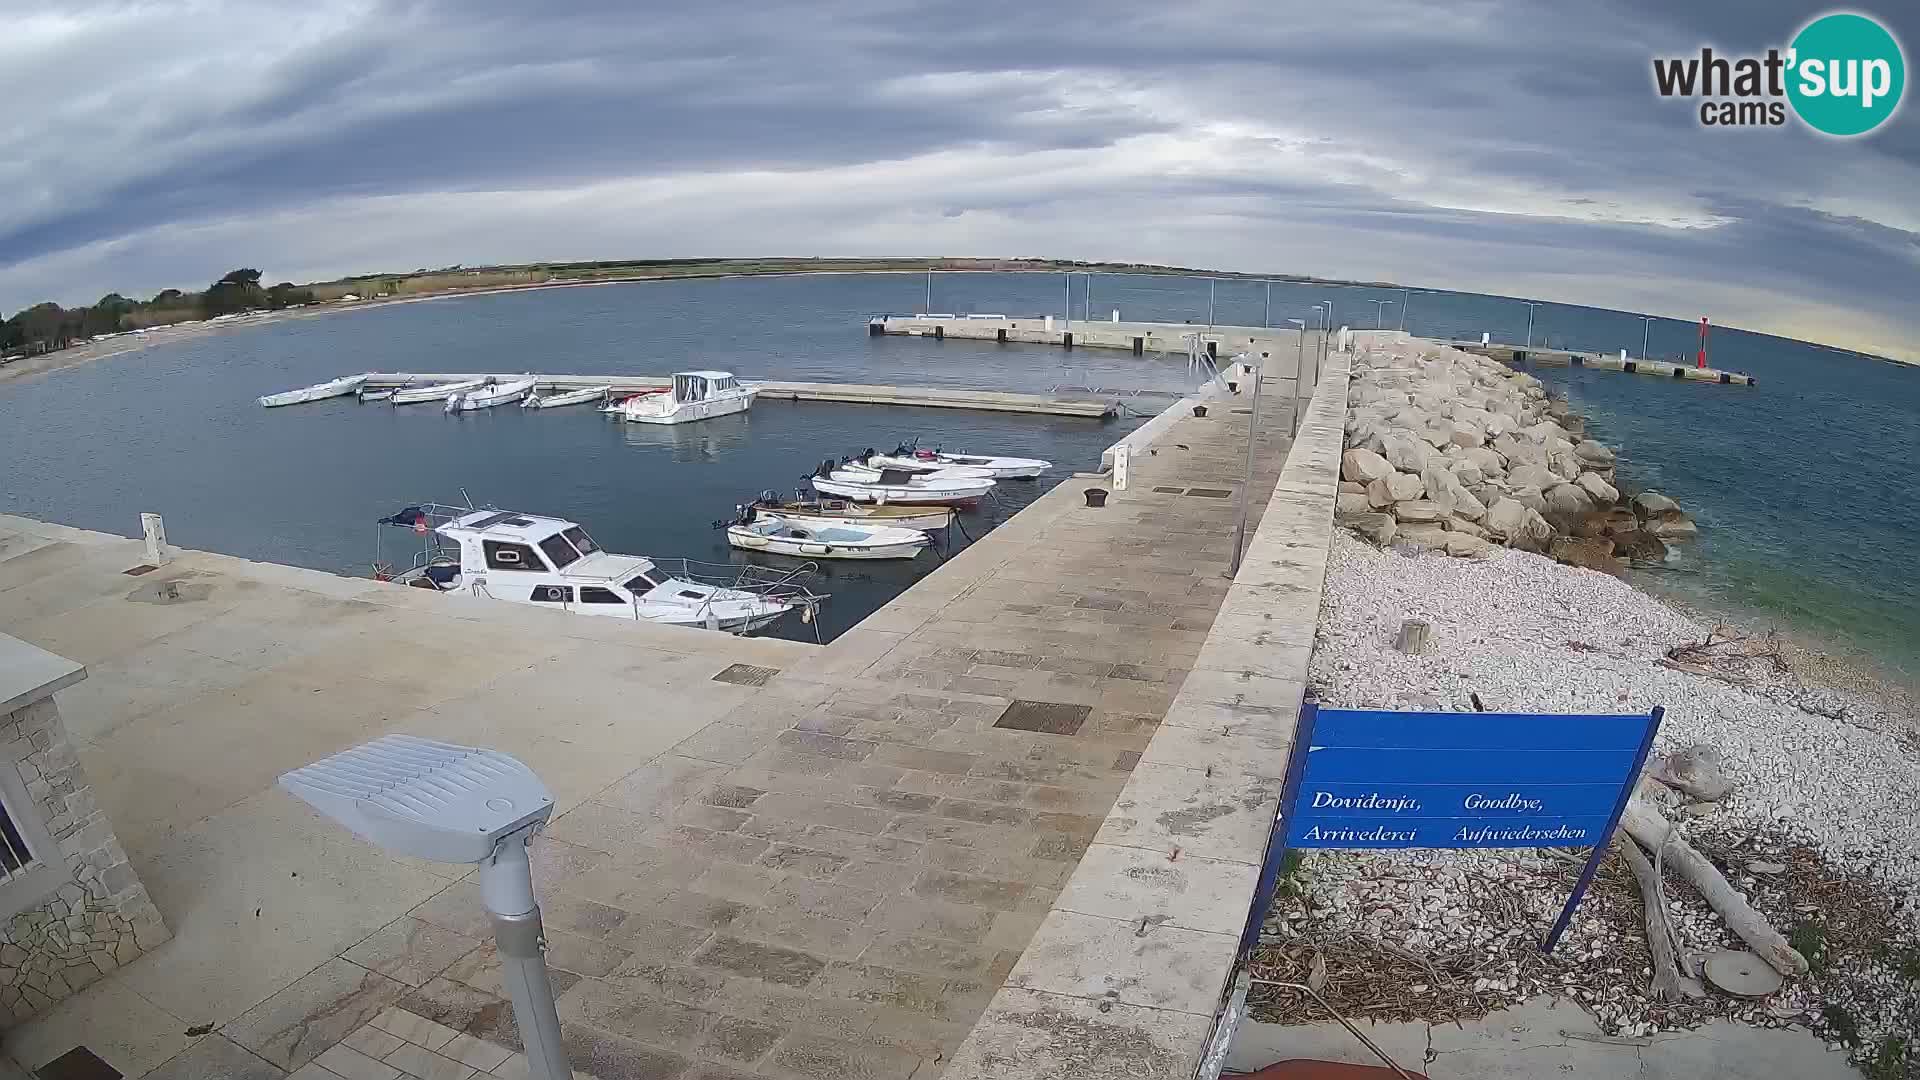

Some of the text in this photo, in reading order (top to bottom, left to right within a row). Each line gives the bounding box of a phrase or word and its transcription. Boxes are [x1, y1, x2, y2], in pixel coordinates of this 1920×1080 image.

[1311, 791, 1422, 812] Doviđenja,
[1464, 793, 1544, 812] Goodbye,
[1303, 825, 1417, 841] Arrivederci
[1452, 824, 1586, 844] Aufwiedersehen
